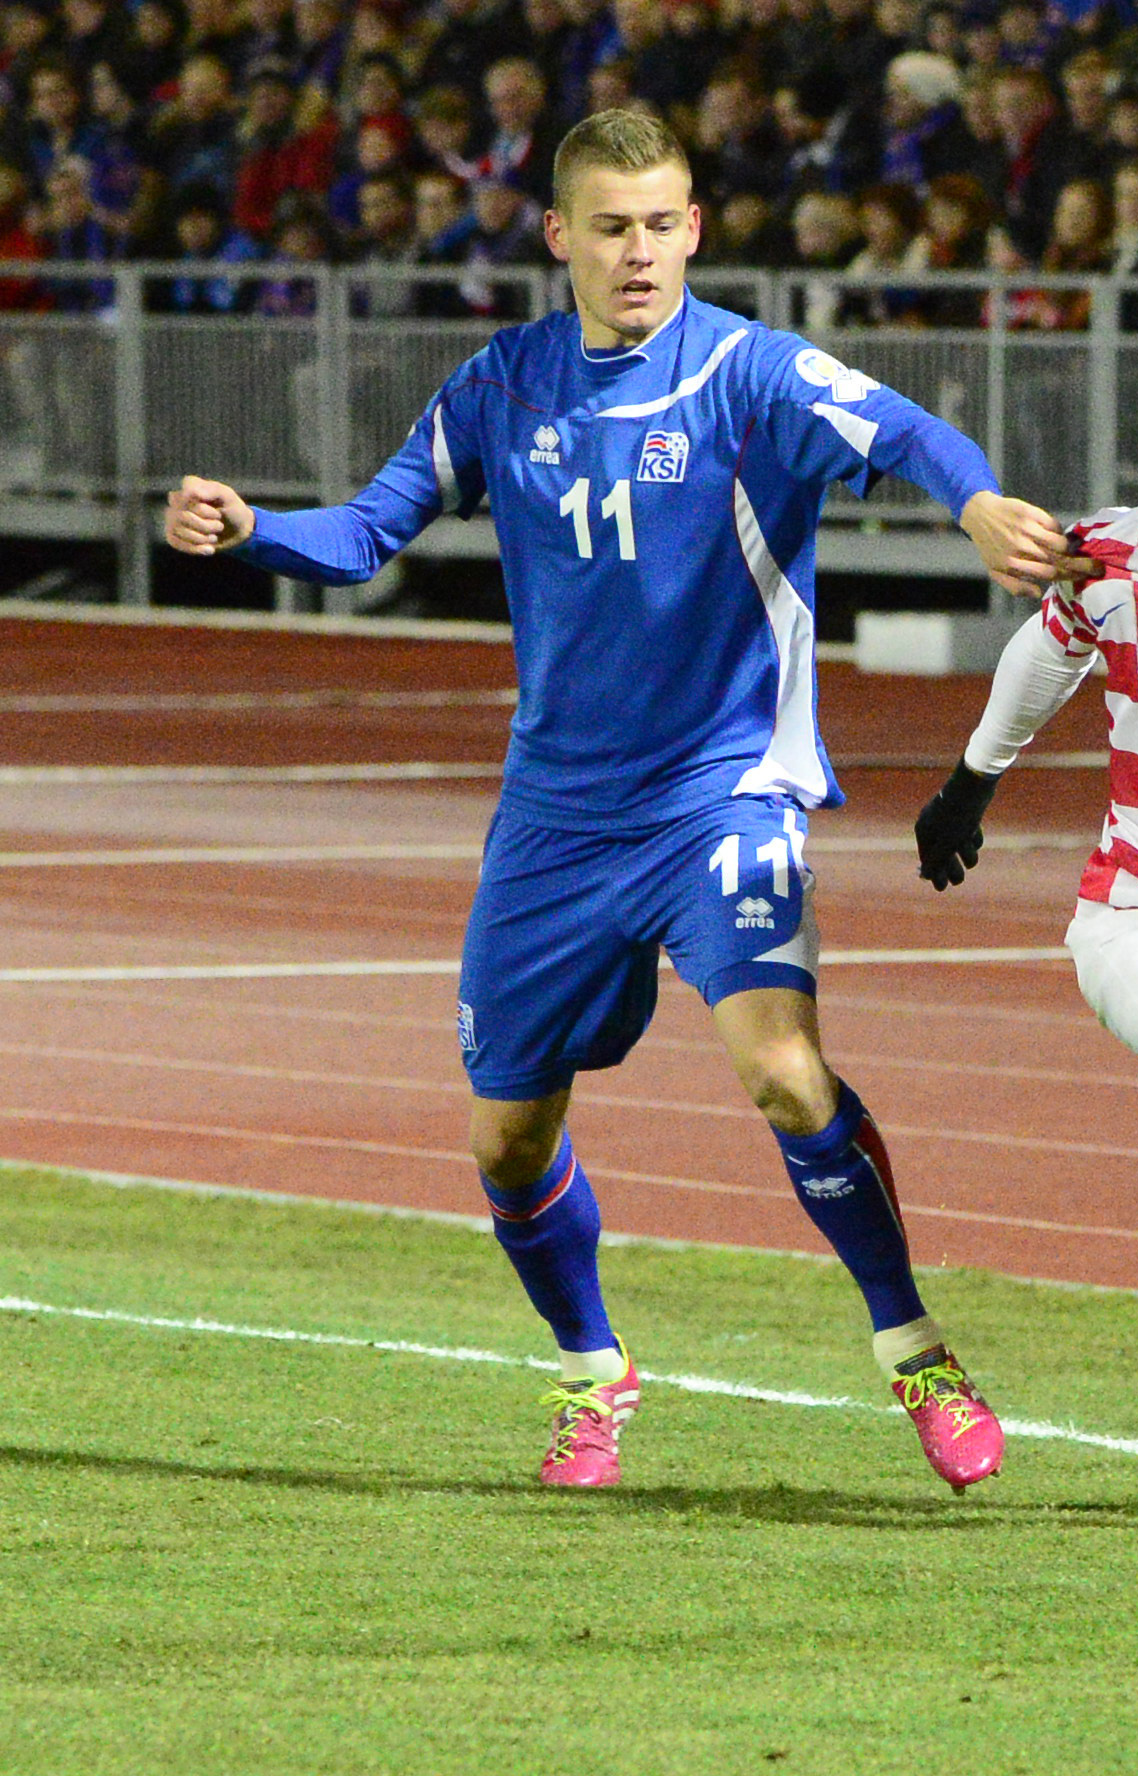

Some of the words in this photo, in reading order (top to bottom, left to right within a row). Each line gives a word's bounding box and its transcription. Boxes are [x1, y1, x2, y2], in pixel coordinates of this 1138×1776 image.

[640, 457, 683, 479] KSI
[559, 477, 636, 560] 11
[709, 833, 789, 899] 11
